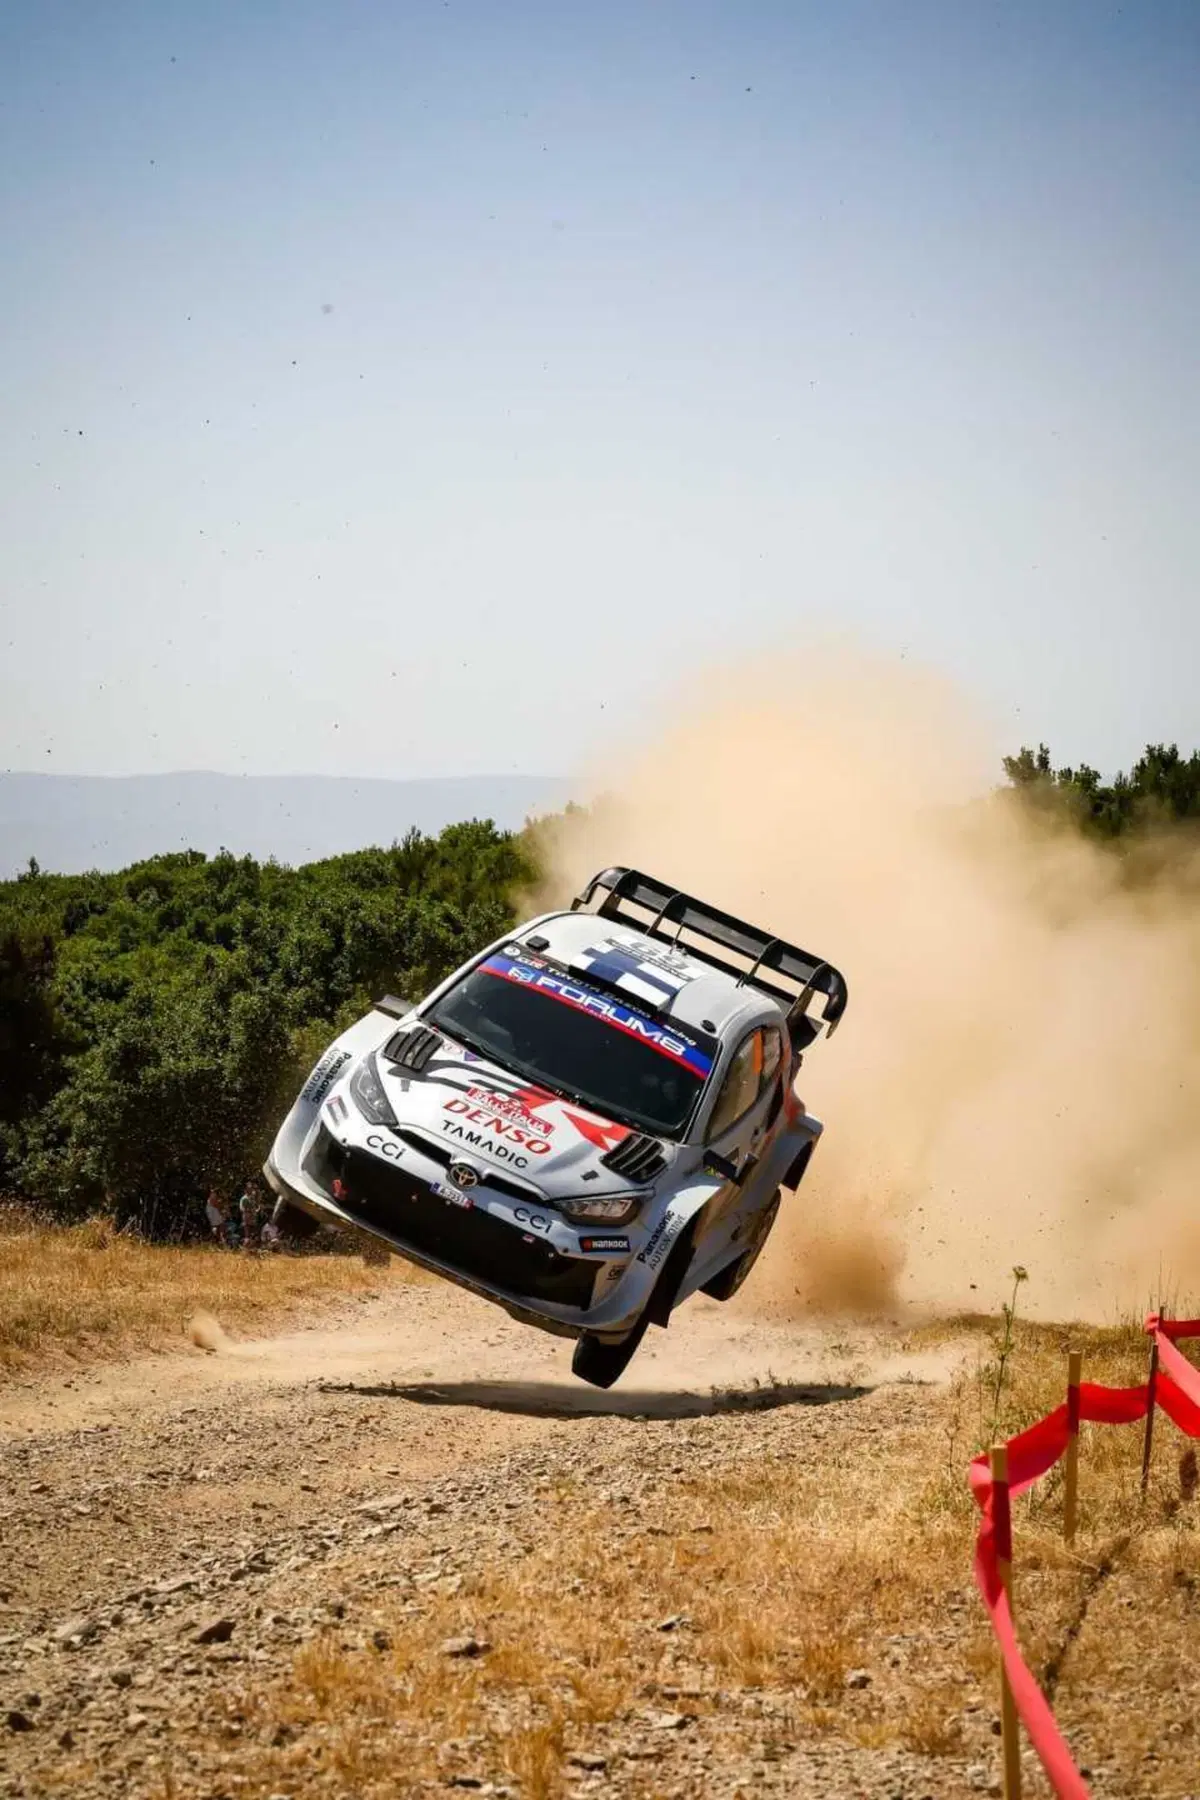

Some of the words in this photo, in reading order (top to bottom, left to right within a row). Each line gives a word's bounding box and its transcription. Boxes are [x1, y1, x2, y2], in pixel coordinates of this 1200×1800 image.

[536, 975, 686, 1056] FORUM8
[312, 1051, 353, 1104] Panasonic
[442, 1119, 528, 1168] TAMADIC
[443, 1099, 551, 1154] DENSO
[637, 1210, 674, 1264] Panasonic
[649, 1215, 686, 1270] AUTOMOTIVE
